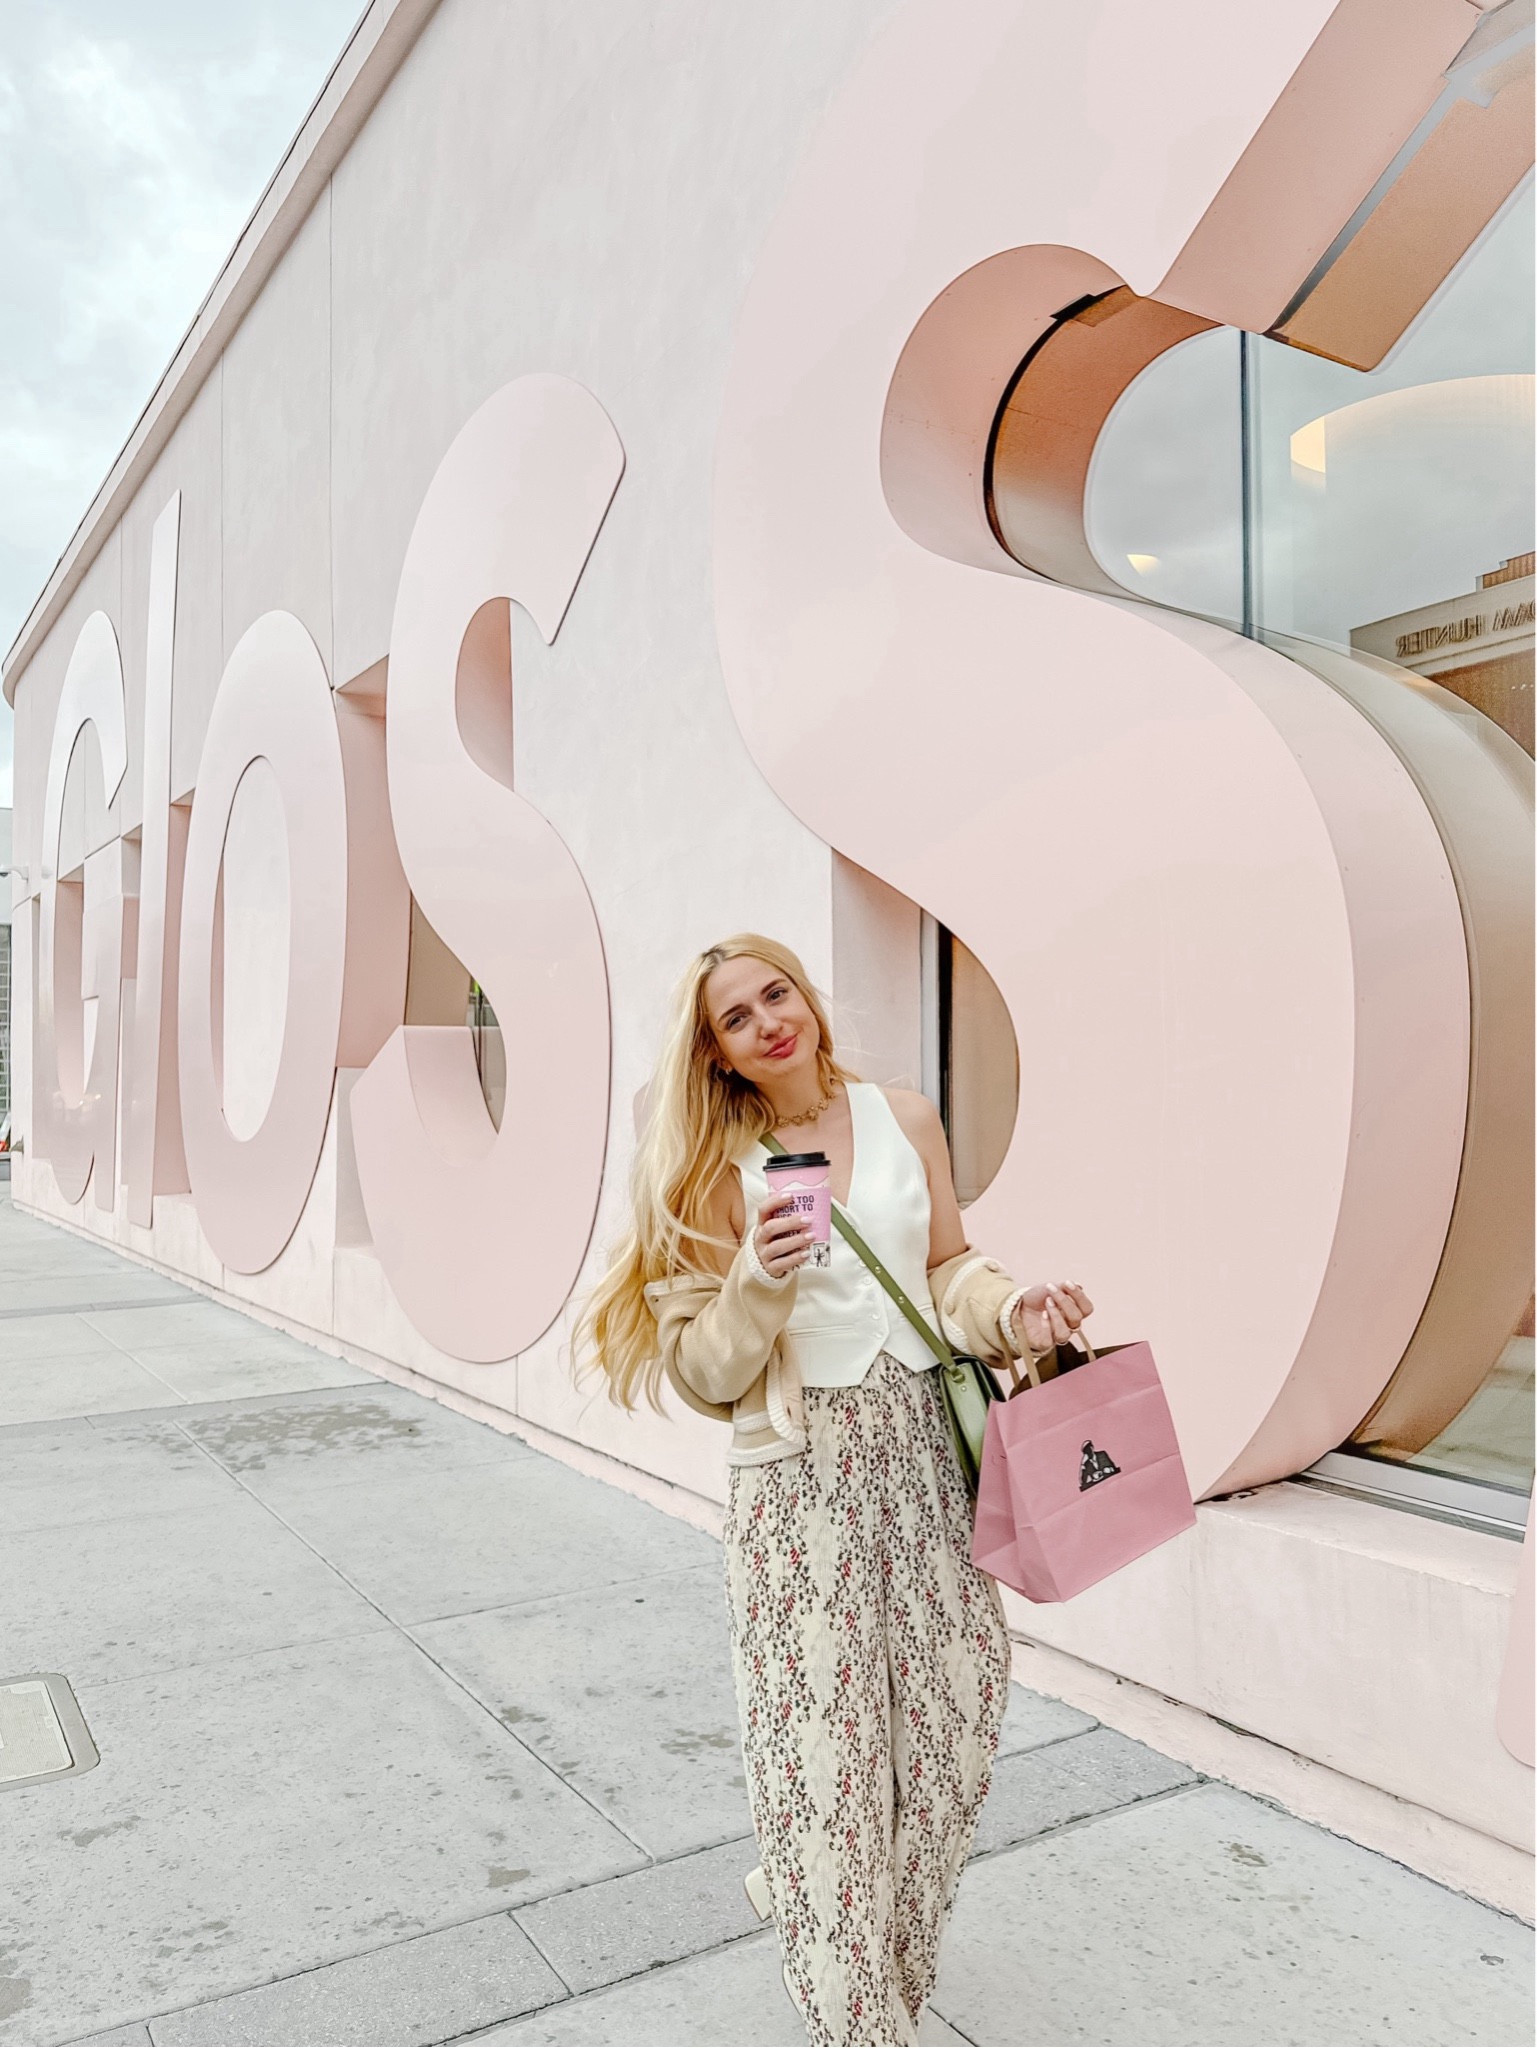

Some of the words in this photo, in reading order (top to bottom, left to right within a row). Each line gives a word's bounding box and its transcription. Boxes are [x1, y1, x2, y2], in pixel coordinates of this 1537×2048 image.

[35, 0, 1535, 1770] Gloss
[797, 1195, 814, 1204] TOO
[801, 1203, 813, 1211] TO
